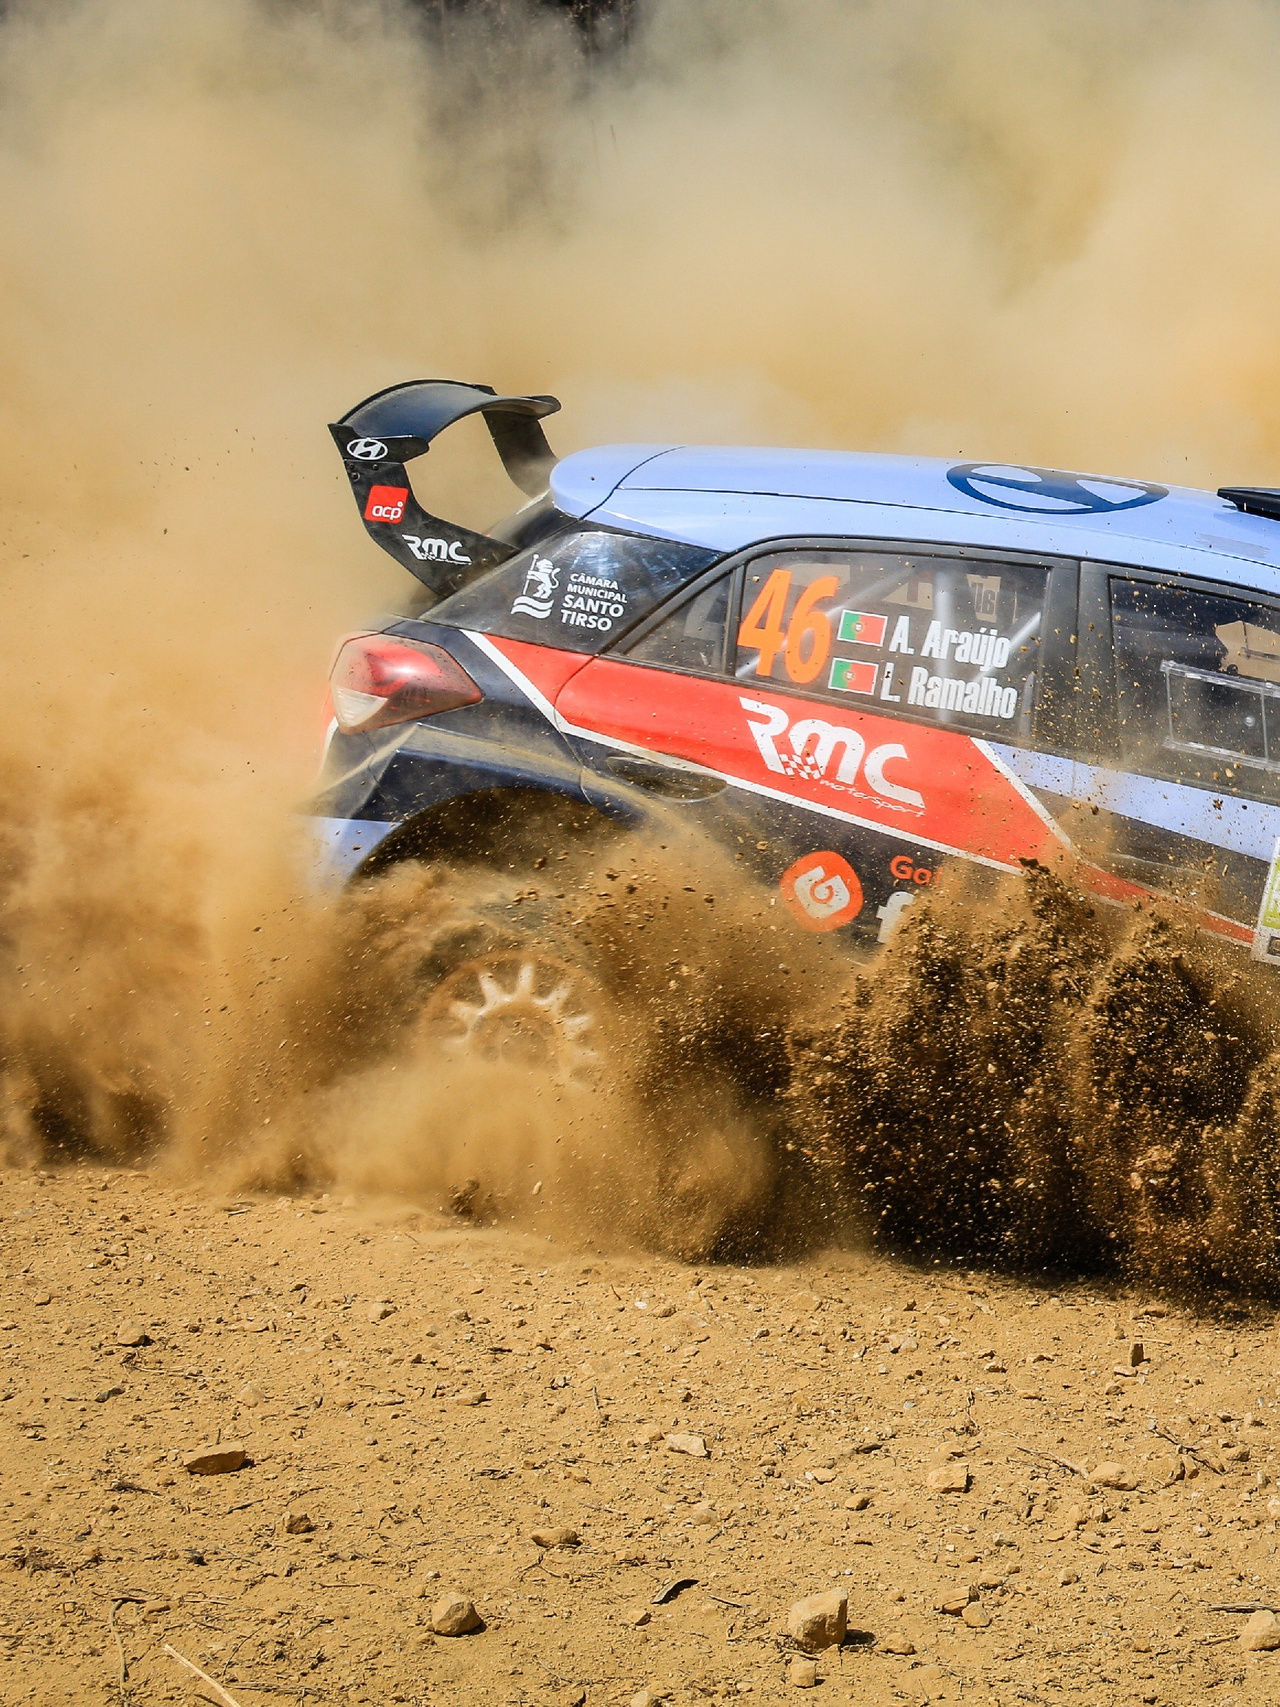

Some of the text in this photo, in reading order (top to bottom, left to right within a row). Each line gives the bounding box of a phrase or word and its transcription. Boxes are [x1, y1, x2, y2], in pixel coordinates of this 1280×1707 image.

[570, 572, 619, 590] CÂMARA
[566, 583, 628, 604] MUNICIPAL
[562, 594, 625, 618] SANTO
[560, 608, 613, 632] TIRSO
[738, 568, 840, 684] 46
[888, 614, 1011, 673] A. Araújo
[907, 666, 1019, 720] Ramalho
